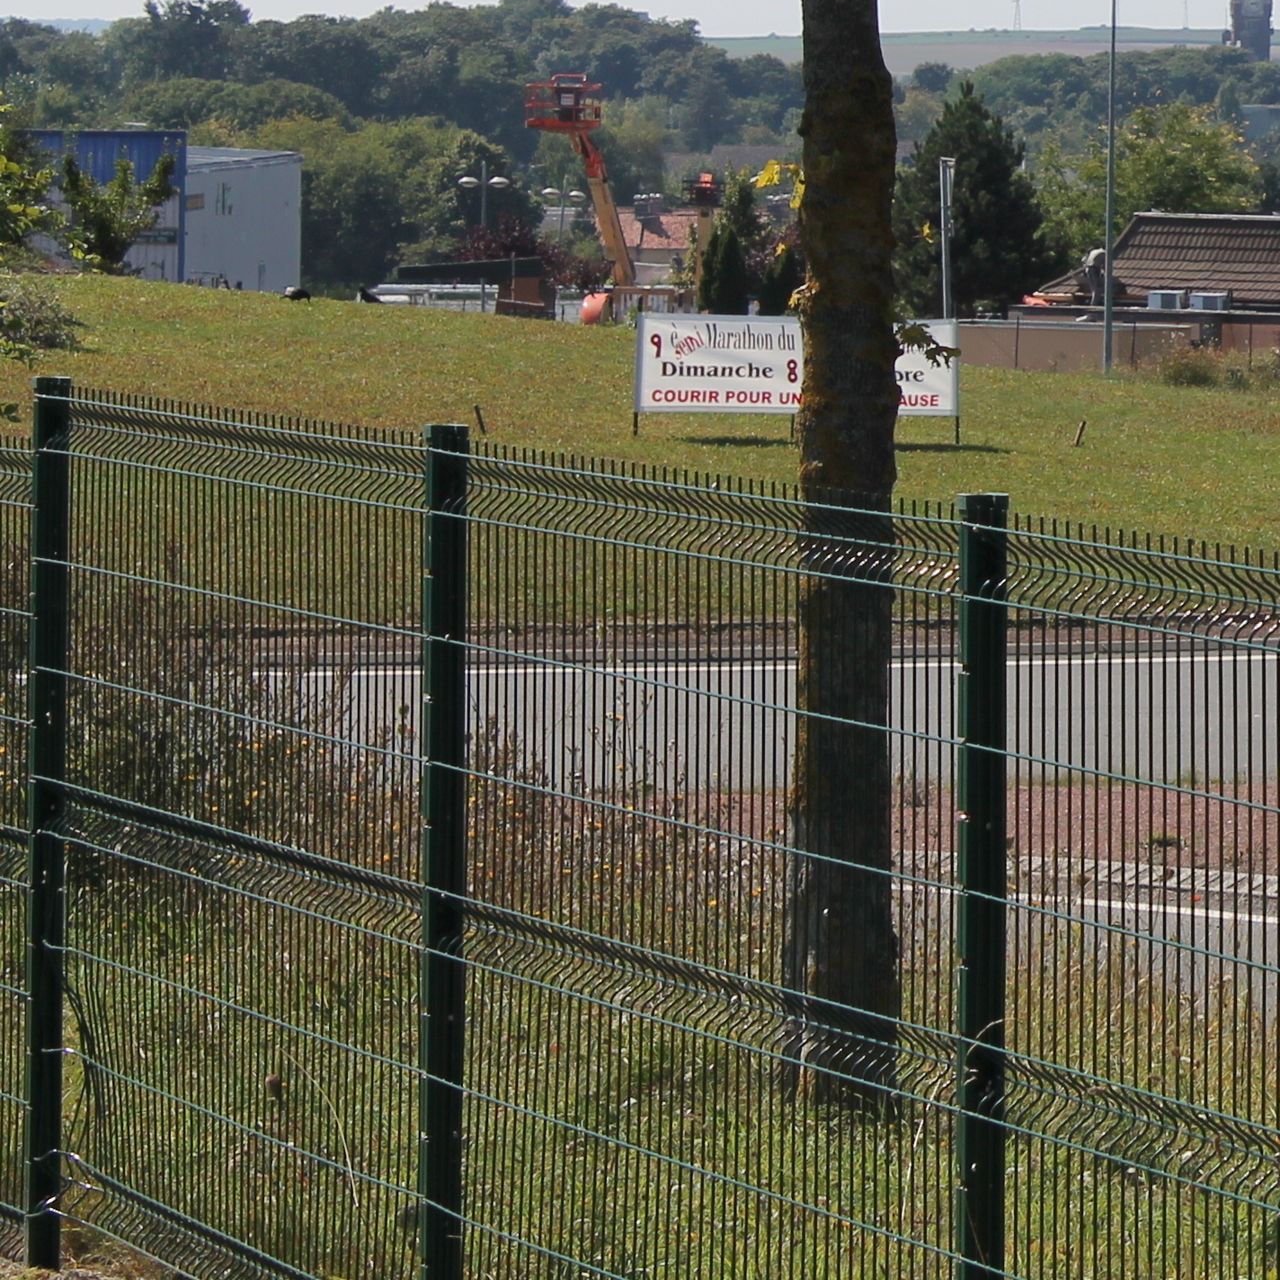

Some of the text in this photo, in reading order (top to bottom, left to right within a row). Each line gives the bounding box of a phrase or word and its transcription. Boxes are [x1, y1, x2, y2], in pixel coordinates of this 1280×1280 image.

[651, 334, 661, 358] 9
[675, 326, 704, 360] semi
[705, 323, 773, 351] Marathon
[778, 325, 795, 351] du
[661, 359, 798, 383] Dimanche 8
[652, 389, 719, 403] COURIR
[725, 391, 772, 404] POUR
[898, 394, 939, 407] AUSE
